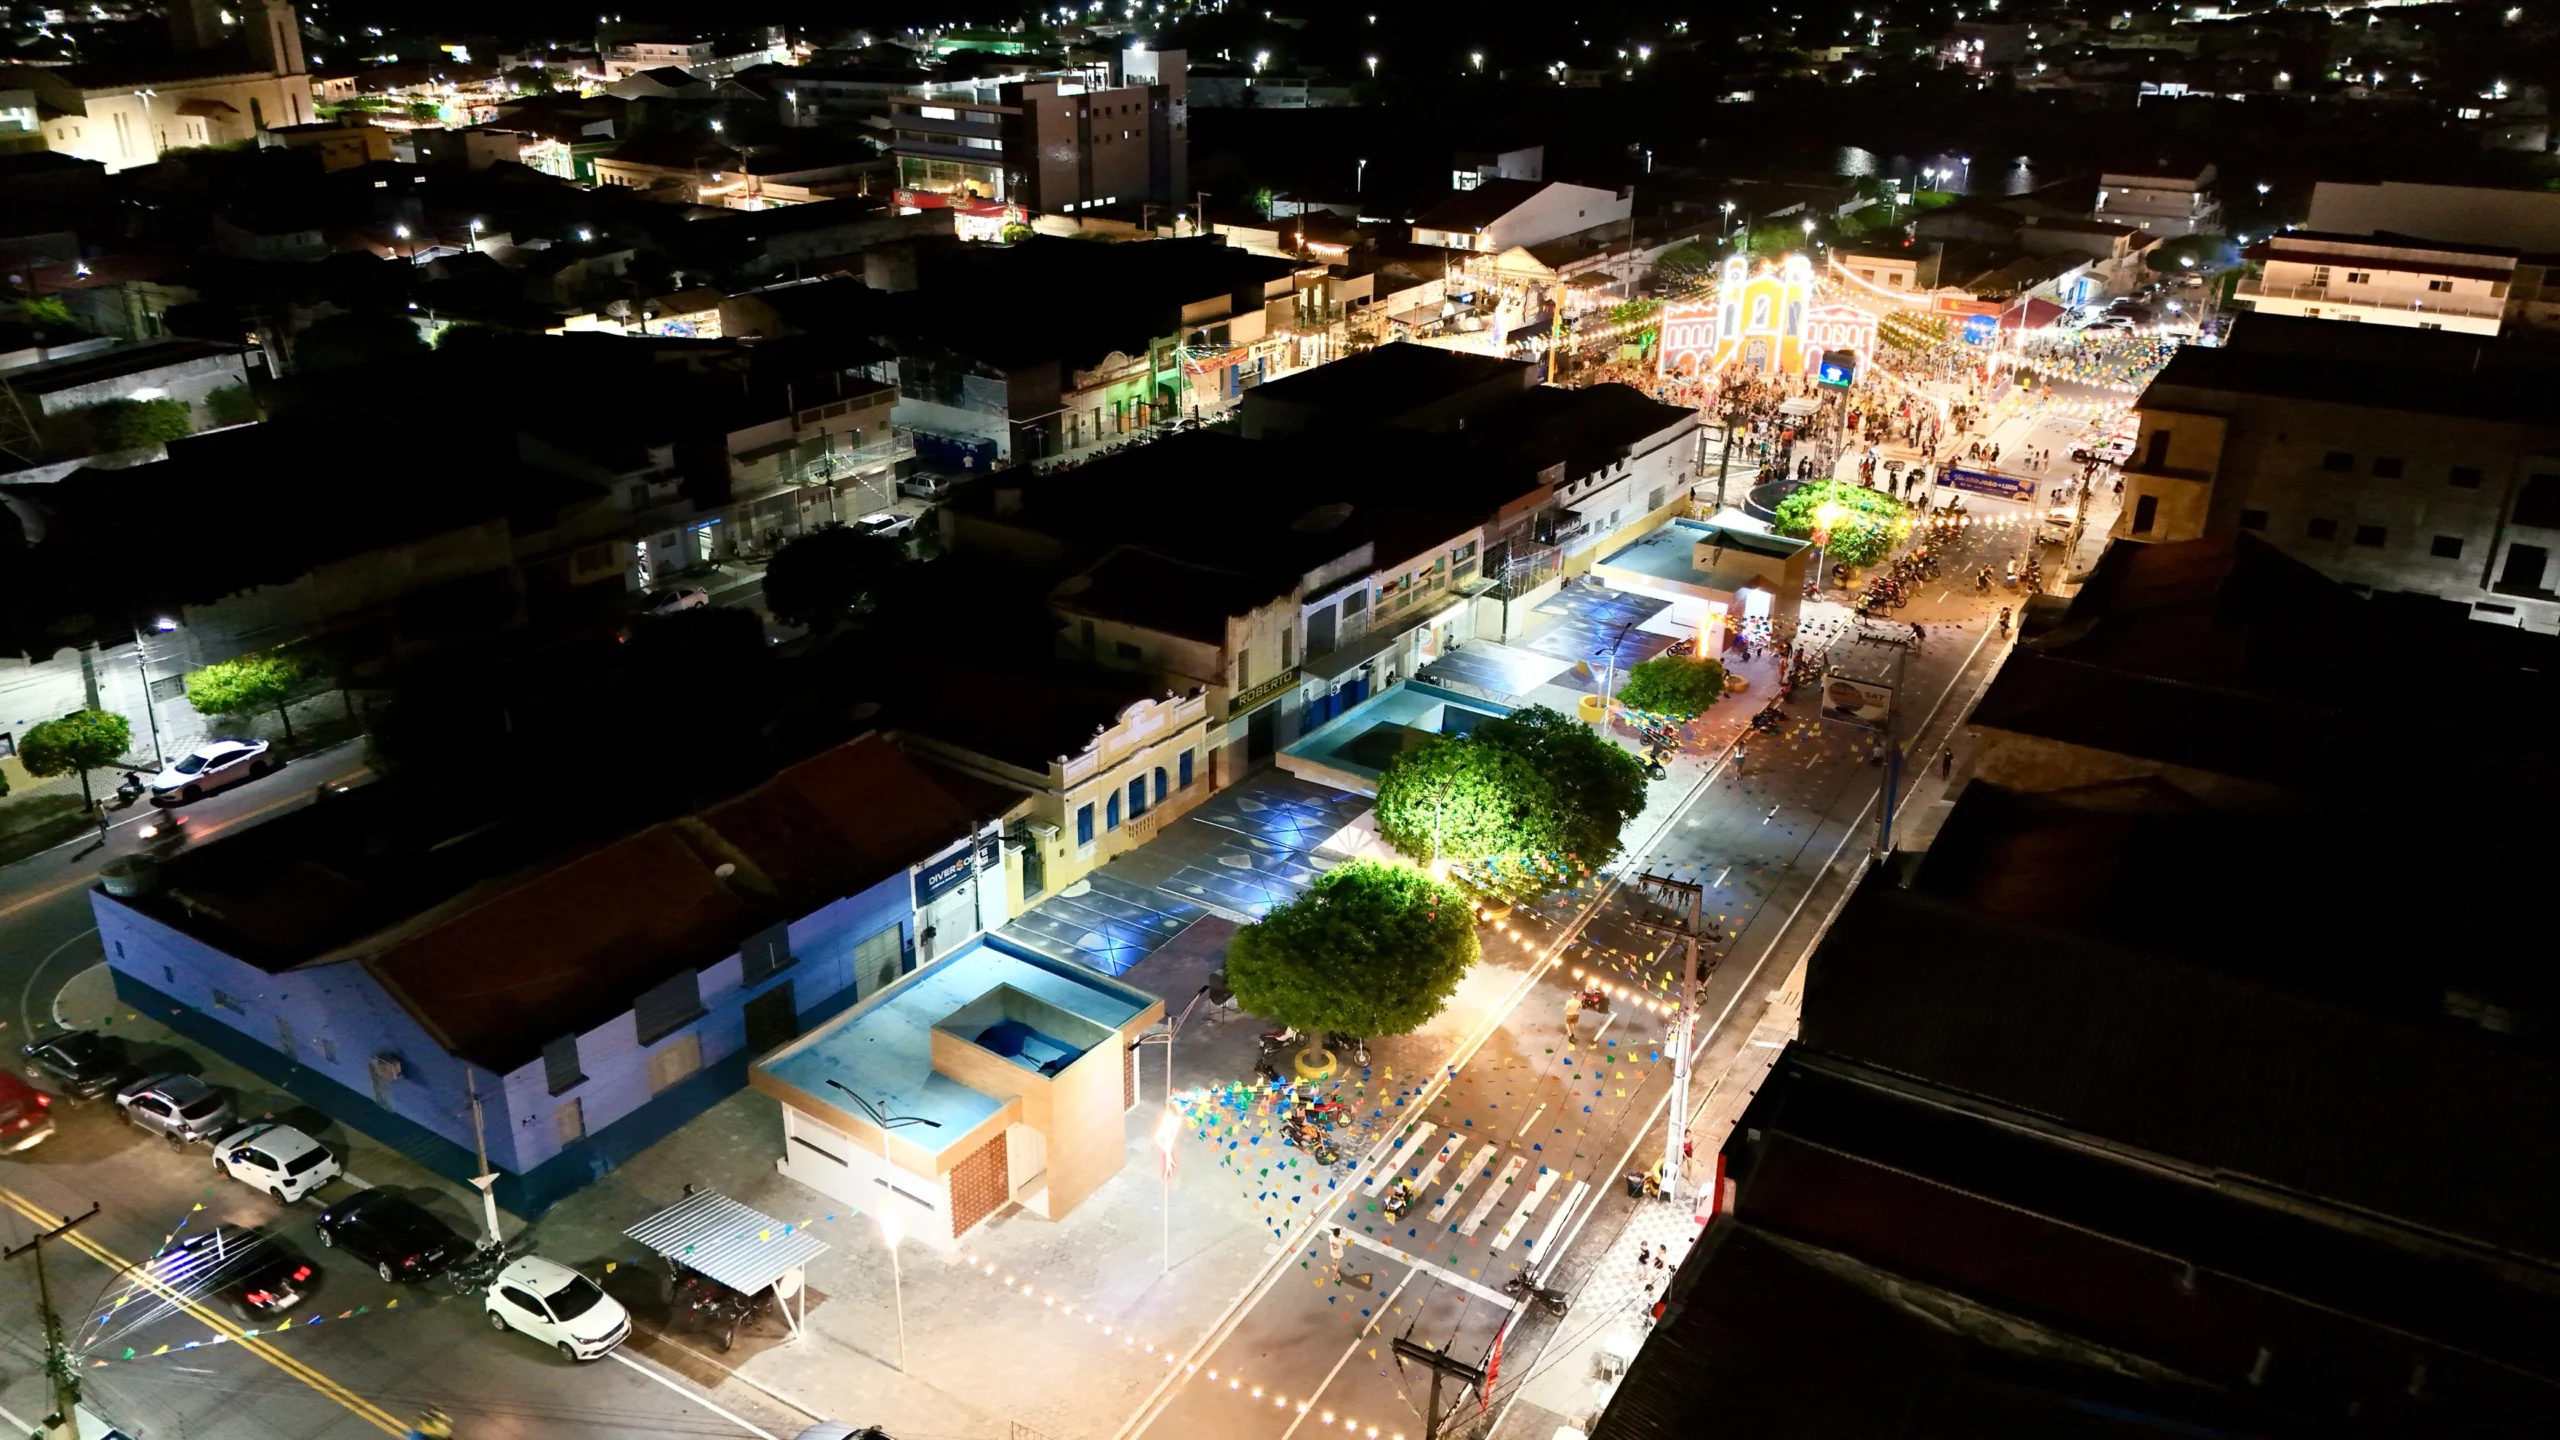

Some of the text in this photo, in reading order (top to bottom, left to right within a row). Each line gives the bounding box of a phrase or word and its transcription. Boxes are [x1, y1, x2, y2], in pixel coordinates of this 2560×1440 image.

[1979, 479, 1998, 487] JOÃO
[1239, 671, 1292, 706] ROBERTO
[1864, 691, 1885, 701] SAT
